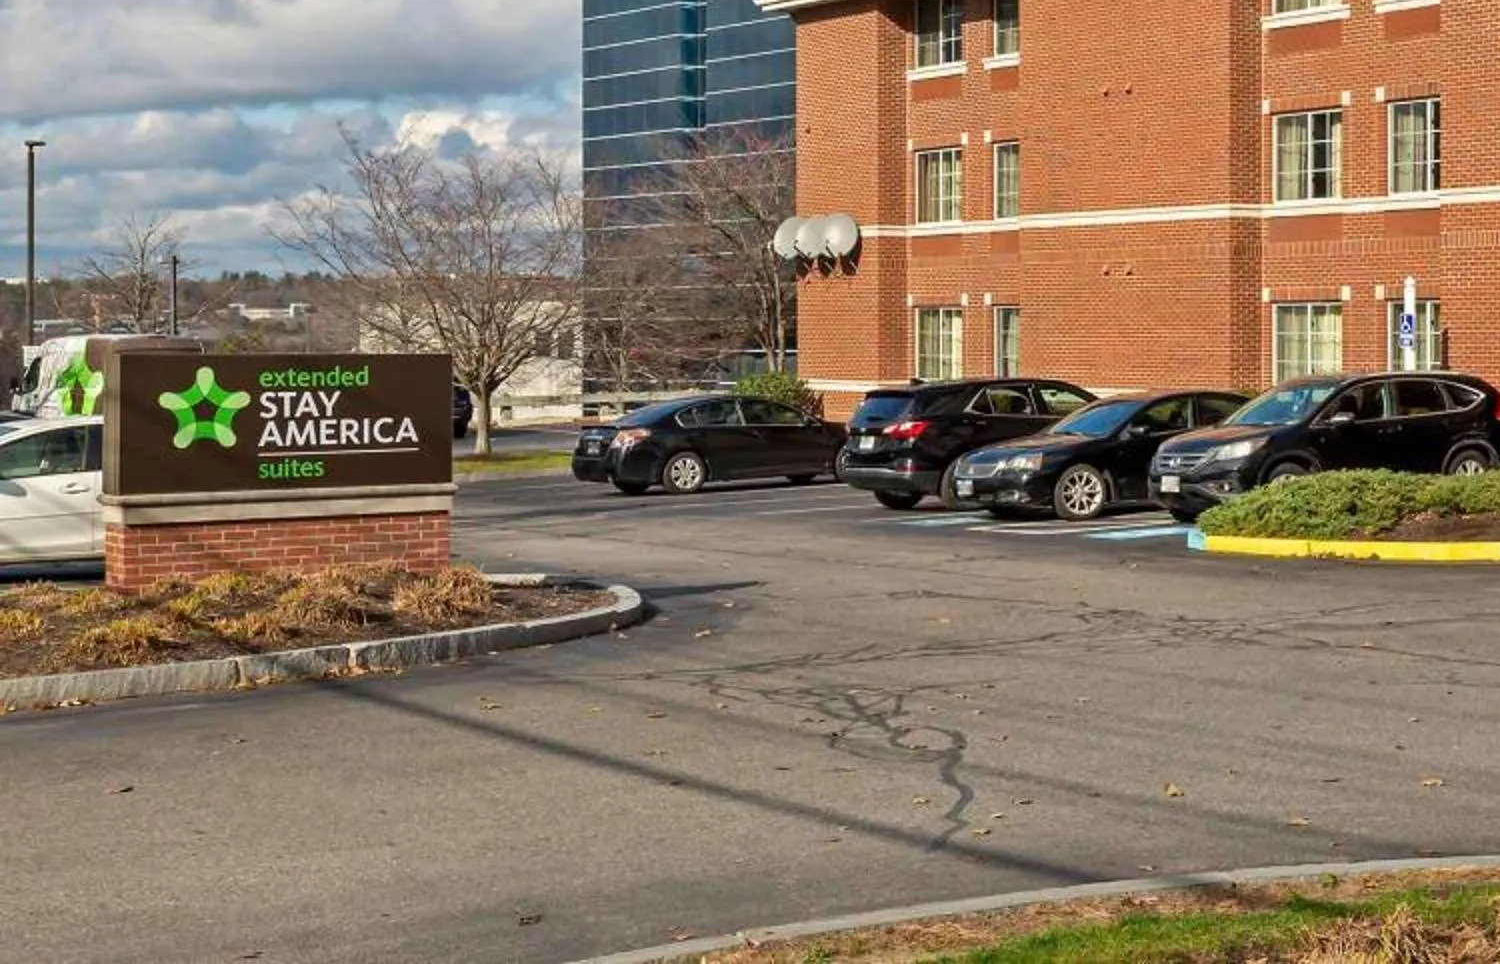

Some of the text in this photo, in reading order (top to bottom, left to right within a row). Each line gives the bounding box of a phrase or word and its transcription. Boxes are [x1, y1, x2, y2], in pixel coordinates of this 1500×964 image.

[258, 365, 370, 387] extended
[259, 390, 342, 418] STAY
[257, 417, 420, 448] AMERICA
[258, 457, 326, 479] suites
